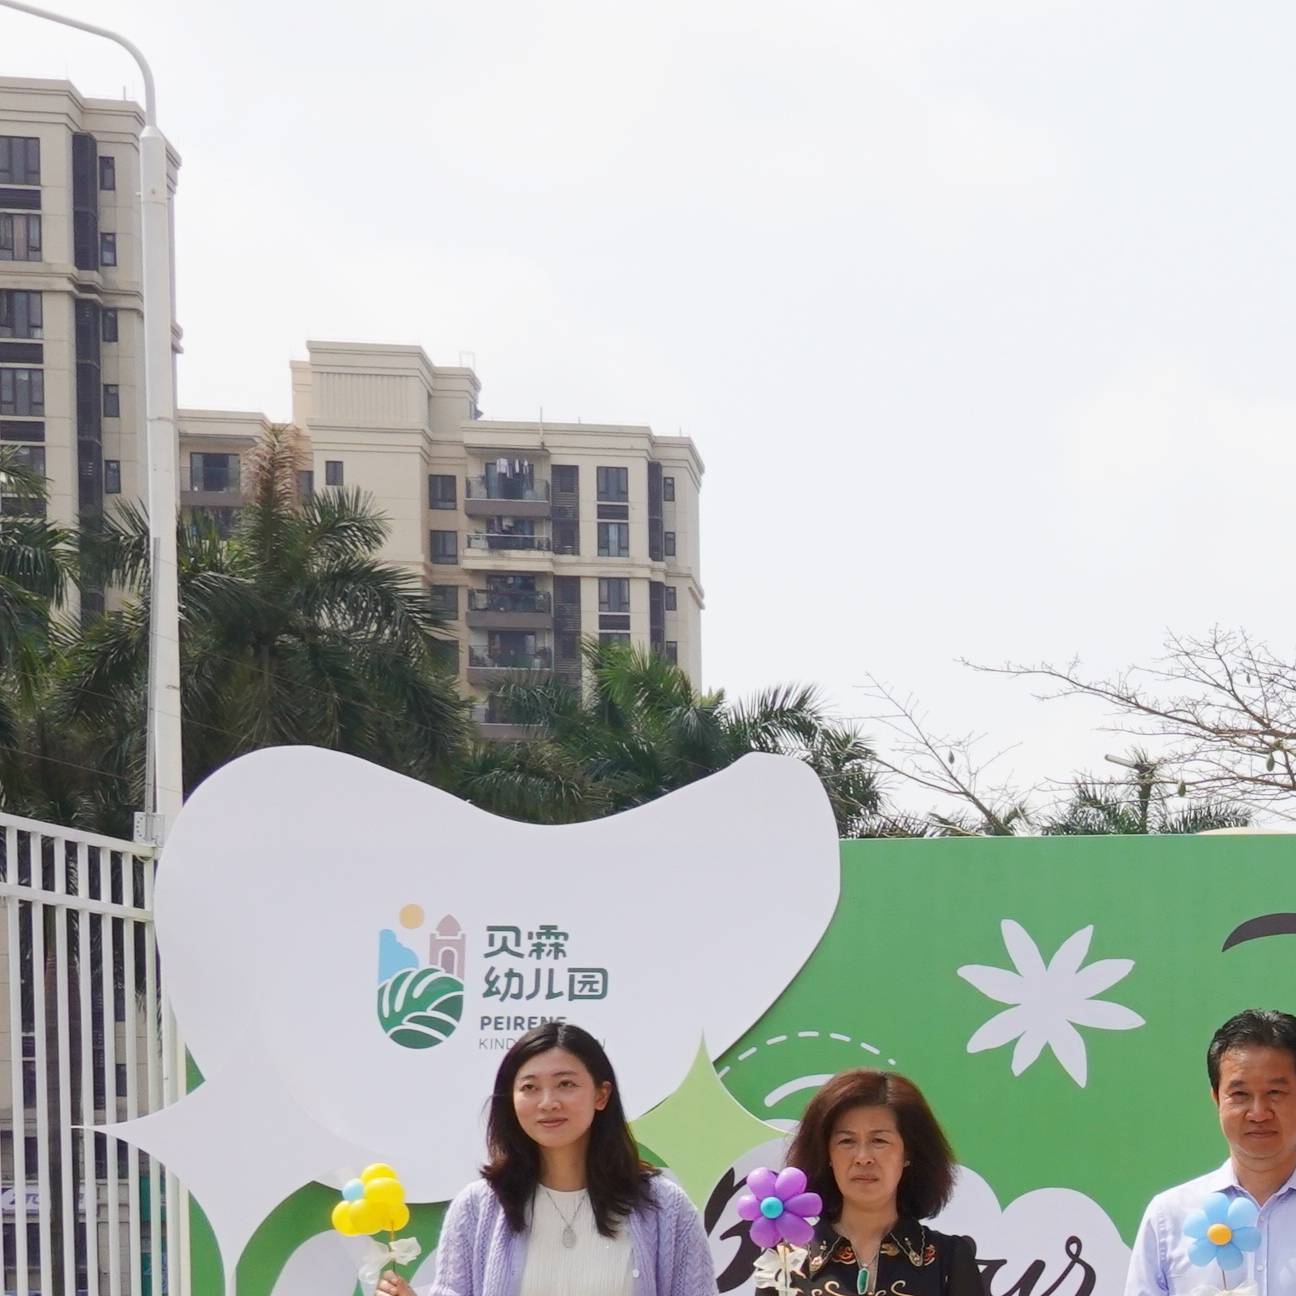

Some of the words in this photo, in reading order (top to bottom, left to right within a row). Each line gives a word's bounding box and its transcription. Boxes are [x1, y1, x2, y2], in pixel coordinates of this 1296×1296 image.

[483, 924, 569, 960] 贝霖
[482, 966, 609, 1002] 幼儿园
